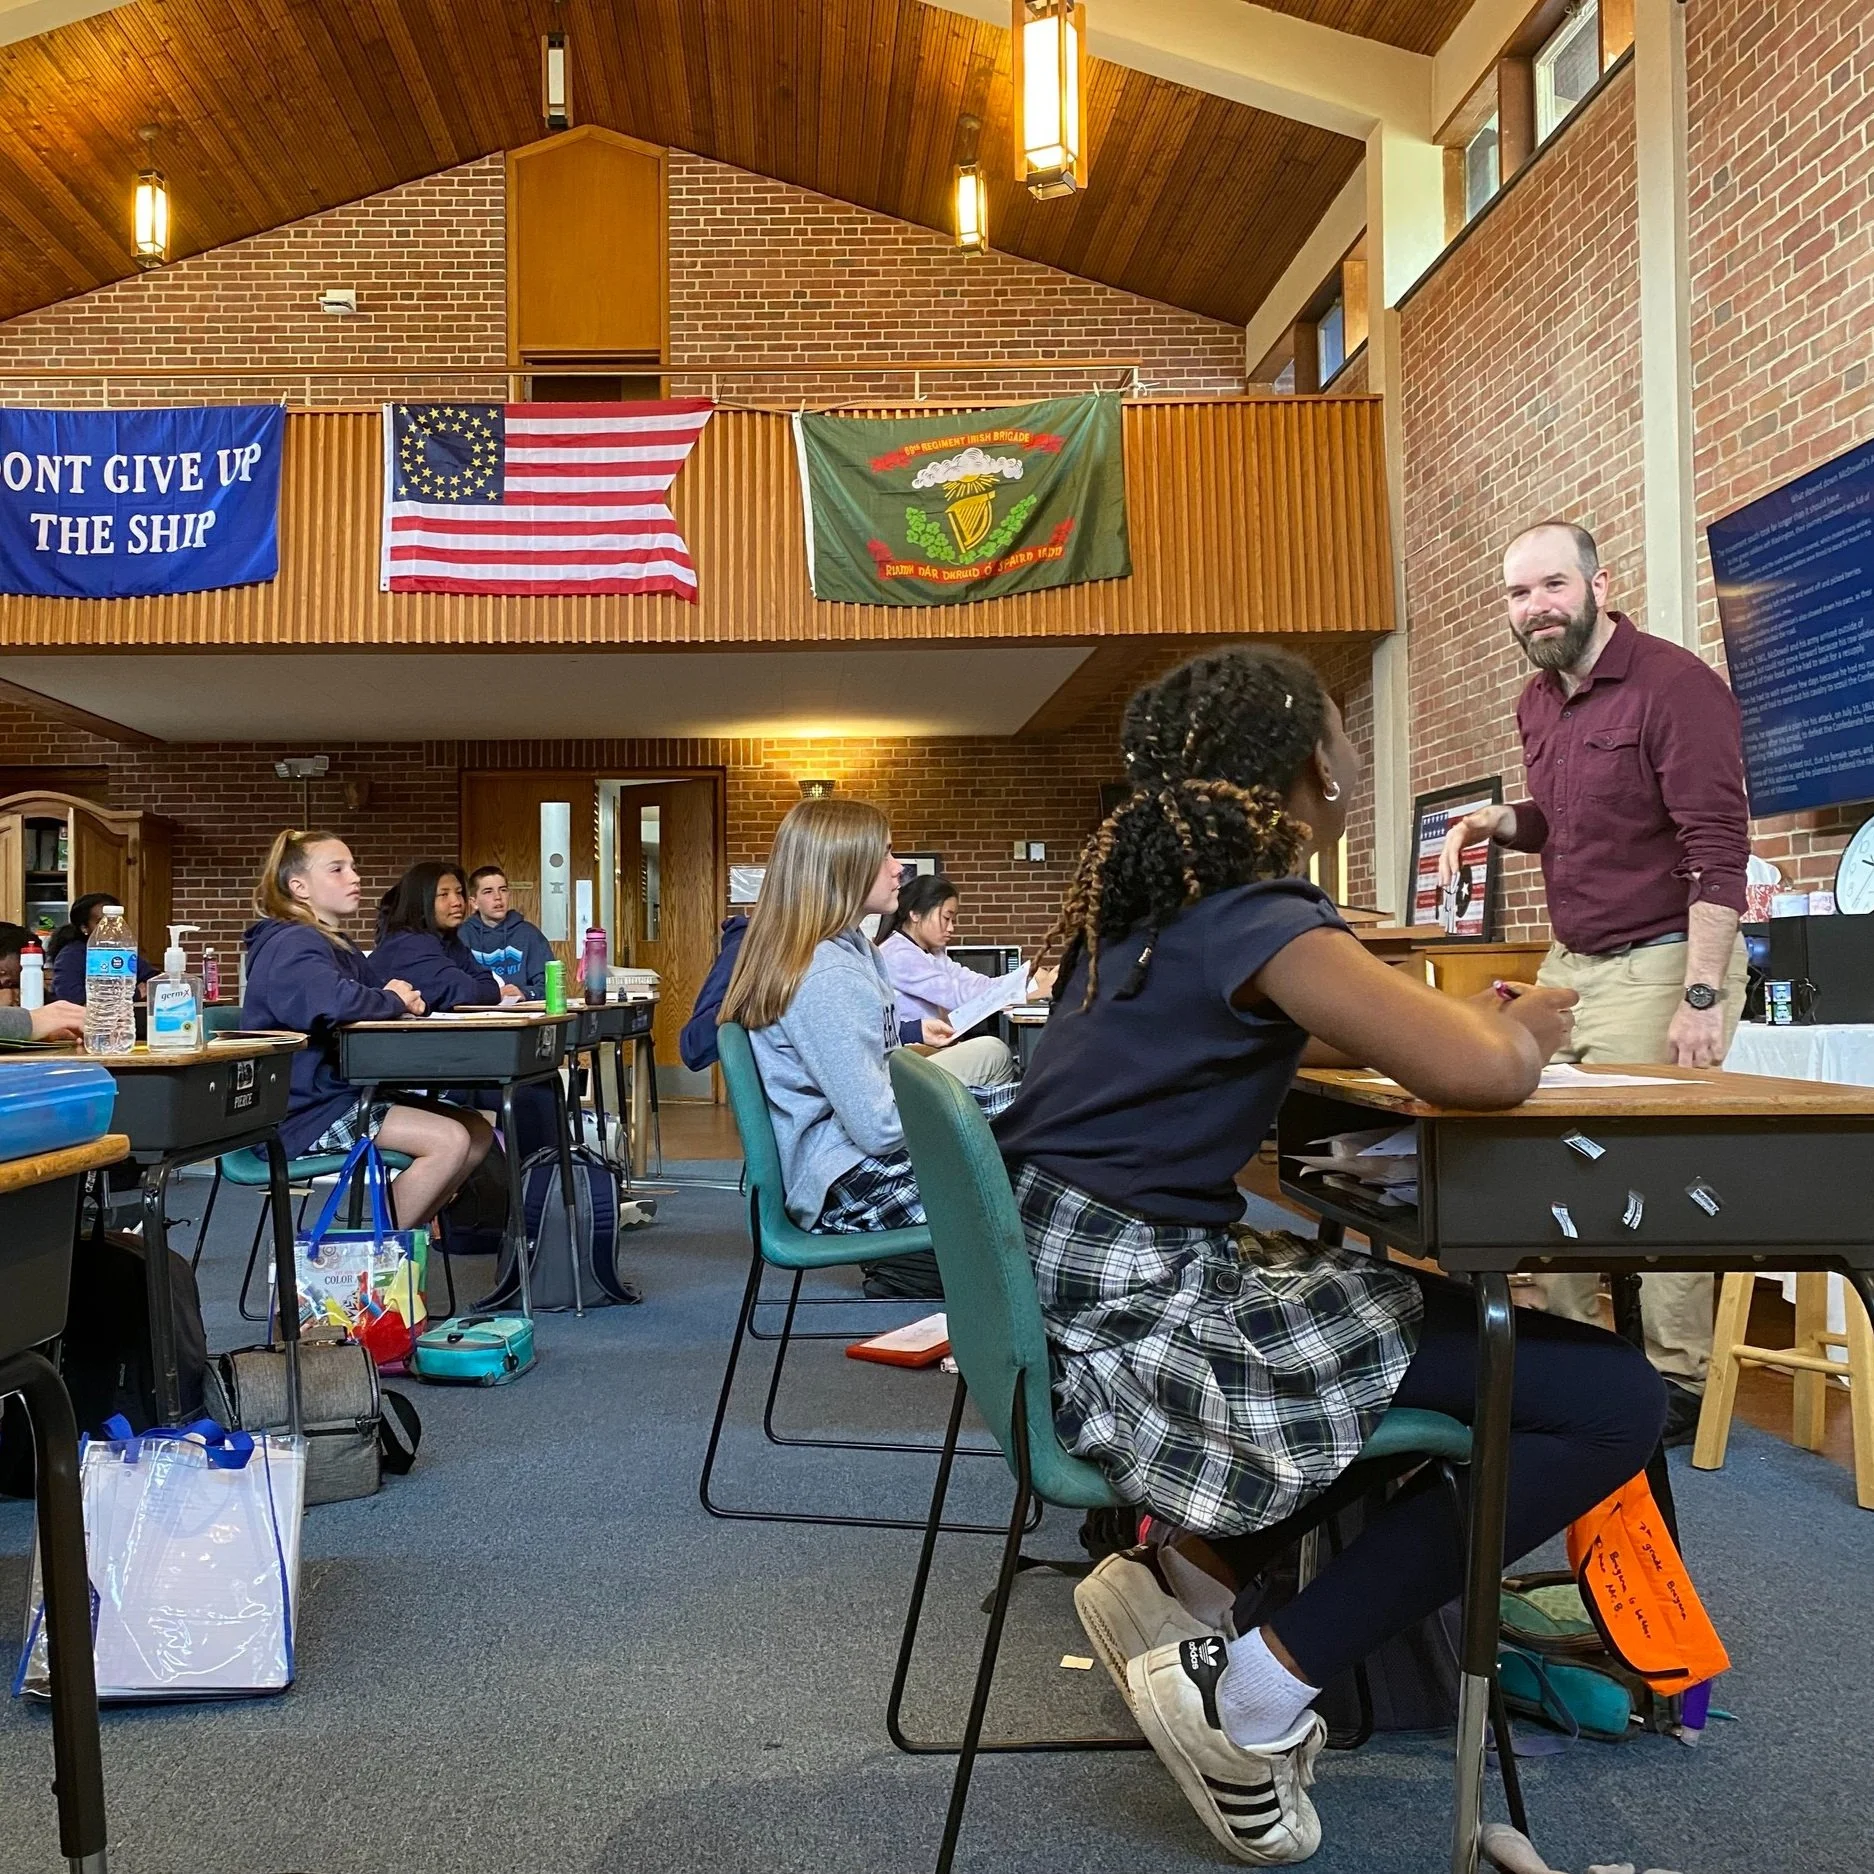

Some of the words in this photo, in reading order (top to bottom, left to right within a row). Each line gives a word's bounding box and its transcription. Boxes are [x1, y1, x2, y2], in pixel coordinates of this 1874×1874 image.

[921, 436, 964, 452] REGIMENT
[968, 432, 991, 444] IRISH
[993, 430, 1030, 442] BRIGADE
[0, 451, 92, 494] ONT
[103, 452, 203, 494] GIVE
[216, 442, 261, 487] UP
[30, 513, 114, 555] THE
[128, 510, 216, 554] SHIP
[324, 1275, 353, 1285] COLOR
[1188, 1641, 1199, 1670] adidas
